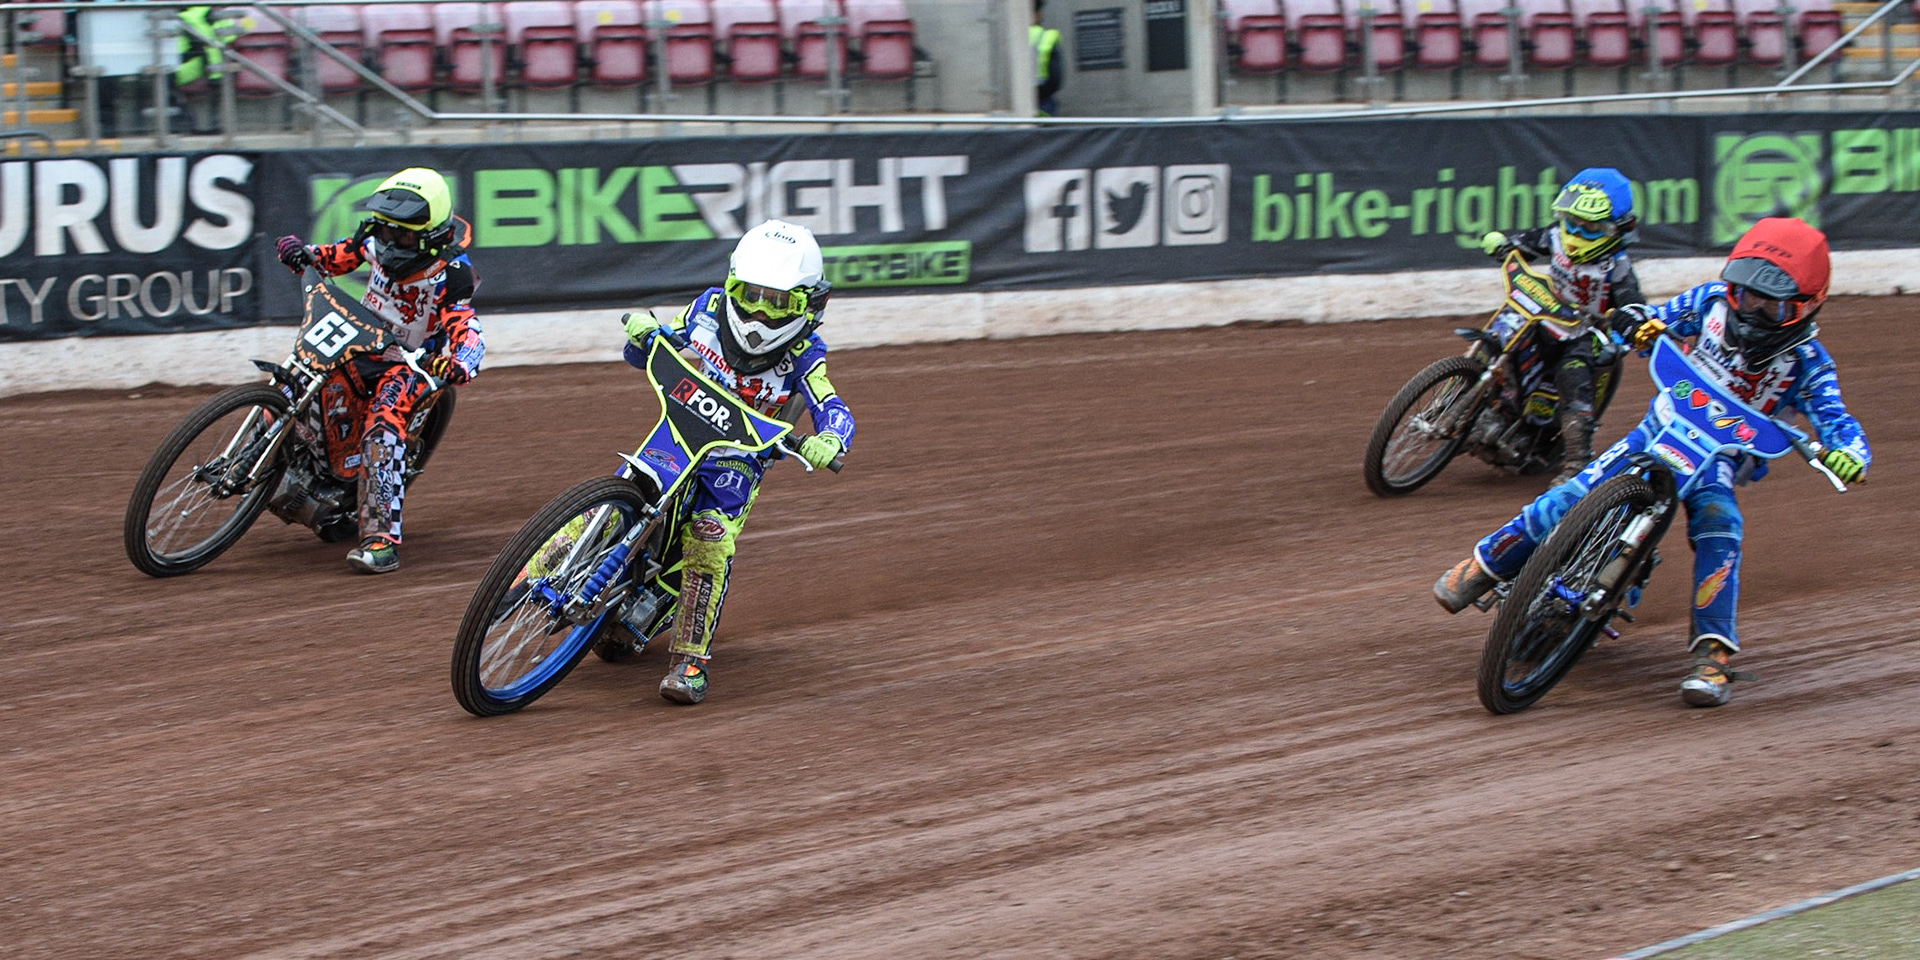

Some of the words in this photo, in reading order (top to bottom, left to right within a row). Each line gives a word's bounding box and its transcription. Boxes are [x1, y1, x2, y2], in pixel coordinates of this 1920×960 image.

[1831, 128, 1920, 193] BI
[1251, 166, 1698, 249] bike-rightm
[826, 248, 965, 283] TORBIKE
[67, 267, 253, 321] GROUP
[304, 311, 359, 357] 63
[780, 358, 792, 372] 5
[702, 581, 713, 606] NEW
[695, 606, 709, 636] ROAD
